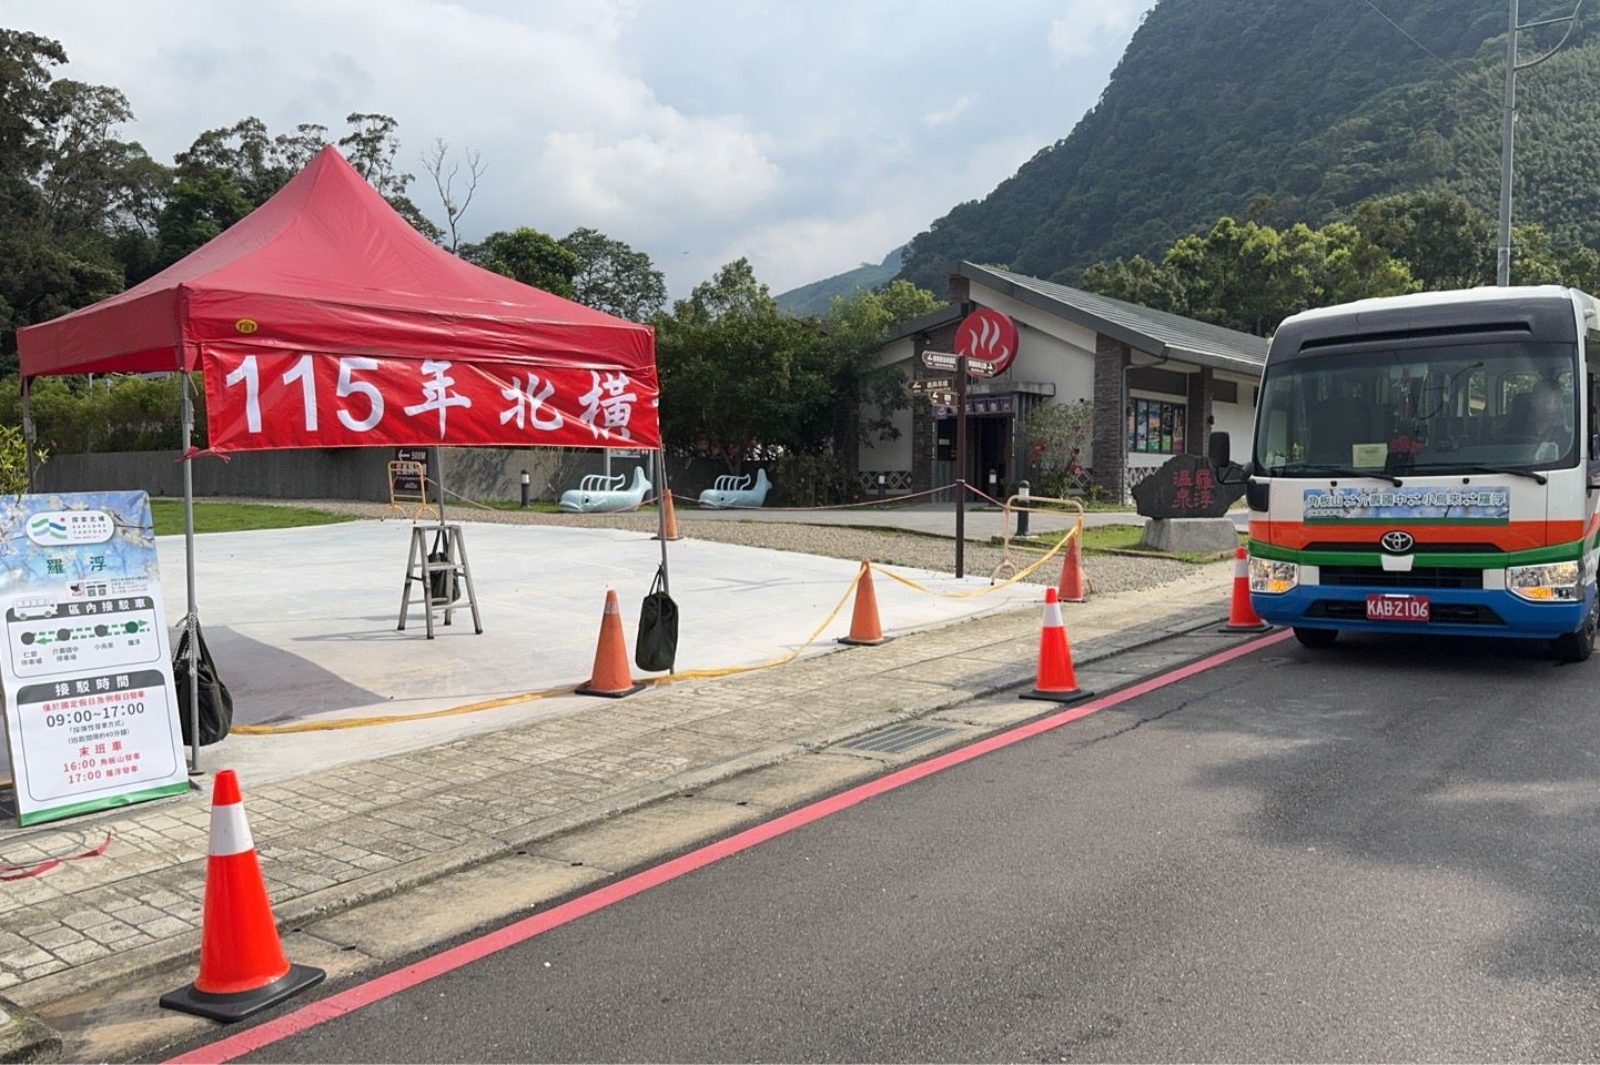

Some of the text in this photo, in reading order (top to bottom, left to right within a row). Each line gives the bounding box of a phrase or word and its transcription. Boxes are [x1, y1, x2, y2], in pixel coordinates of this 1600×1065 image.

[225, 354, 660, 440] 115年北橫
[1306, 494, 1344, 508] 角板山
[1477, 492, 1507, 506] 羅浮
[46, 555, 108, 575] 羅浮
[68, 598, 146, 615] 區內接駁車
[1367, 600, 1429, 618] KAB-2106
[55, 674, 130, 697] 接駁時間
[46, 702, 145, 728] 09:00~17:00
[79, 741, 123, 758] 末班車
[63, 758, 96, 773] 16:00
[68, 770, 102, 784] 17:00
